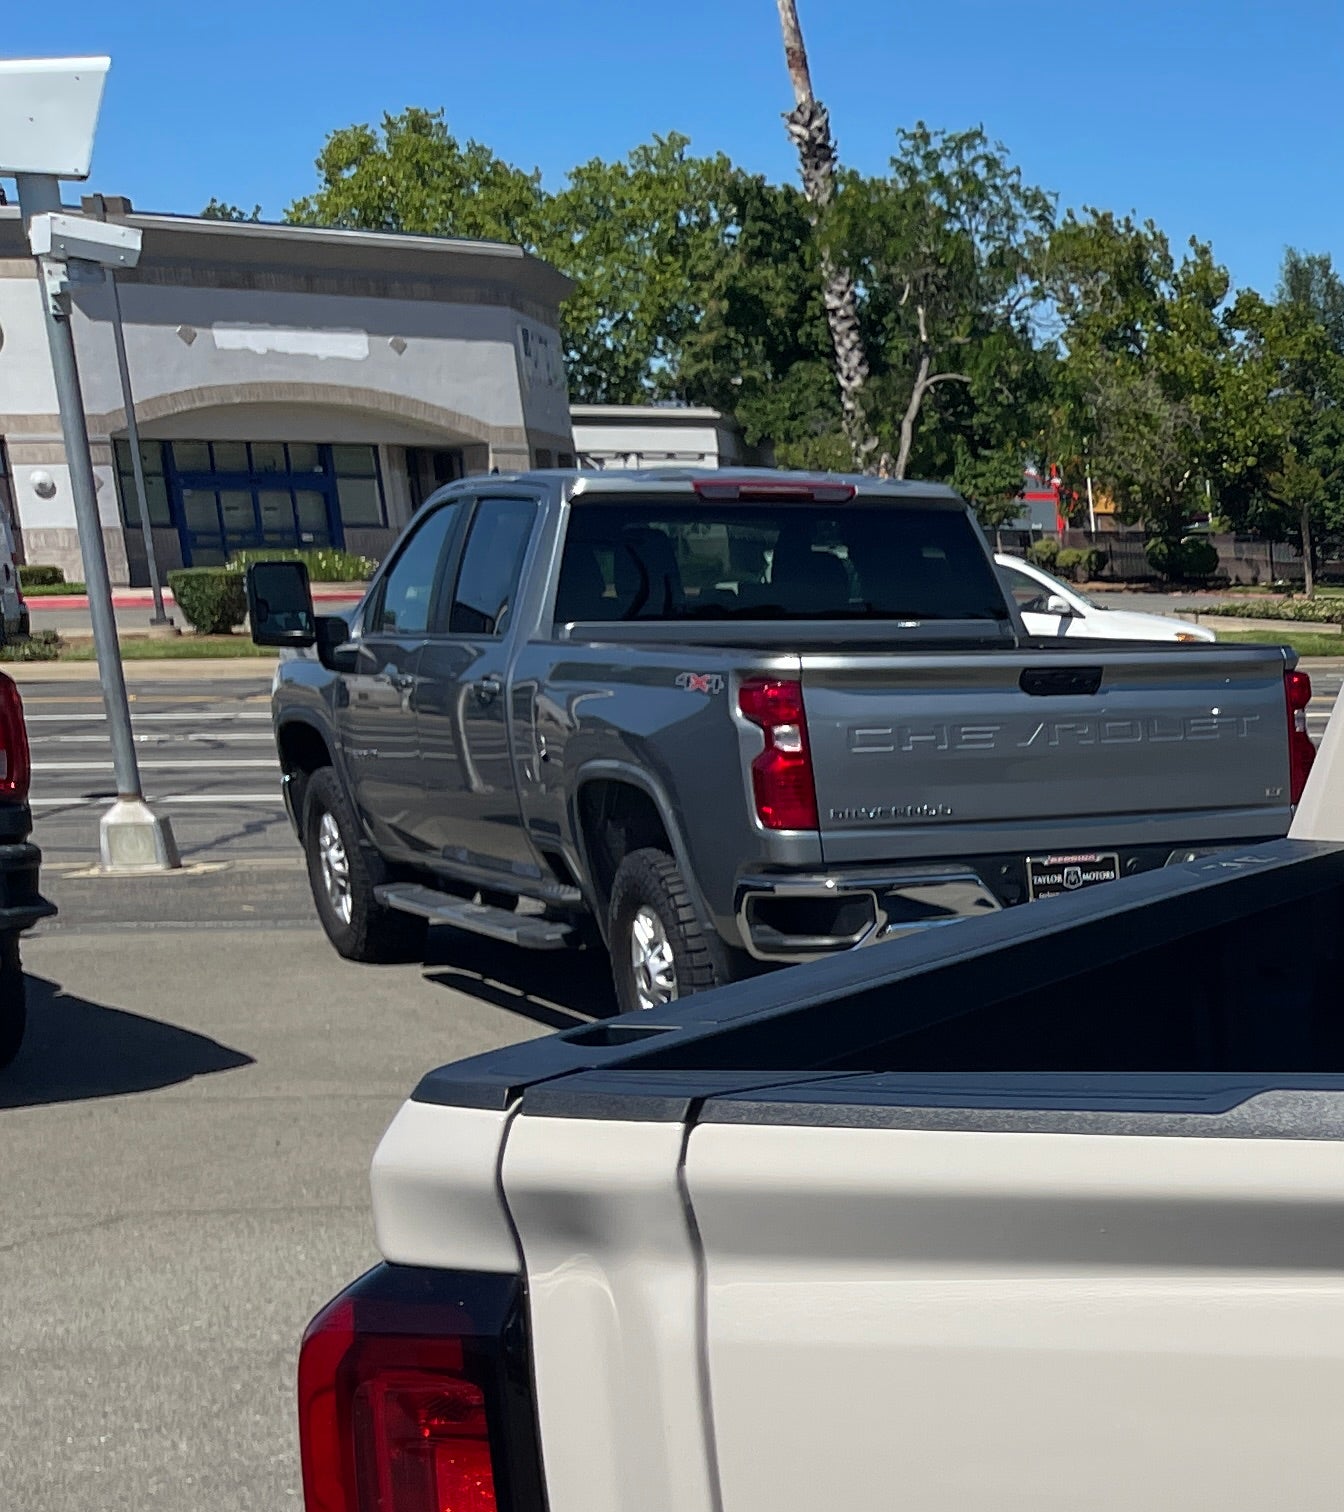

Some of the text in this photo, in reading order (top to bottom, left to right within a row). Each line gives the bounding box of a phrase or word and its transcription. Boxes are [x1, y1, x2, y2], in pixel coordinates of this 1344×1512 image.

[846, 714, 1260, 754] CHEVROLET
[1033, 870, 1115, 884] TAYLOR MOTORS
